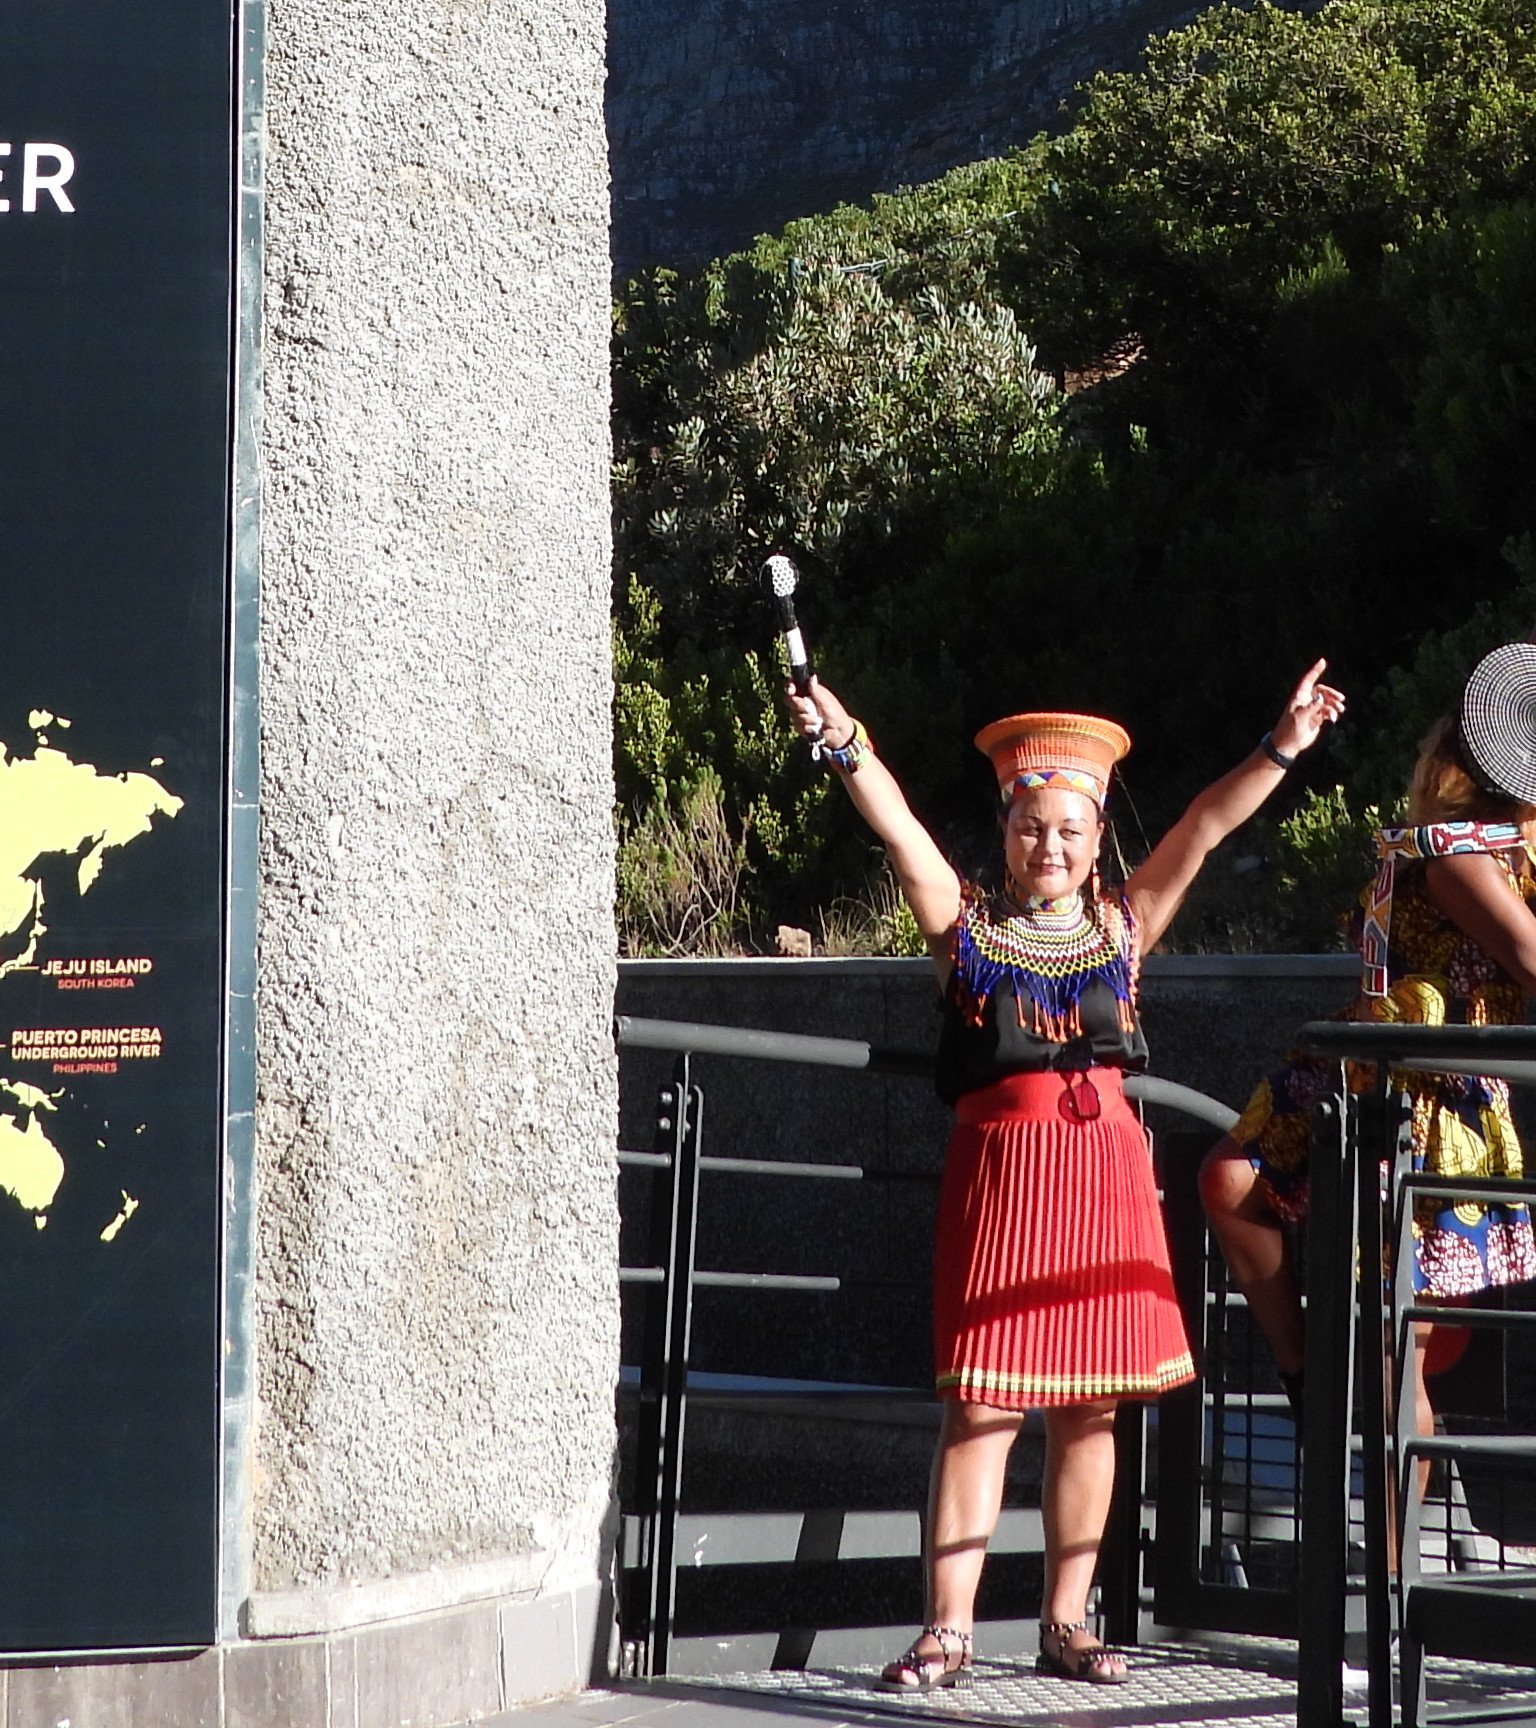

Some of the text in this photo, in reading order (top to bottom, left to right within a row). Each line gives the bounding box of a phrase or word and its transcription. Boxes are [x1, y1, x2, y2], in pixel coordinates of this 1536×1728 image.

[41, 959, 152, 975] JEJU ISLAND
[58, 978, 135, 989] SOUTH KOREA
[12, 1028, 162, 1045] PUERTO PRINCESA
[11, 1044, 161, 1060] UNDERGROUND RIVER
[53, 1063, 117, 1073] PHILIPPINES
